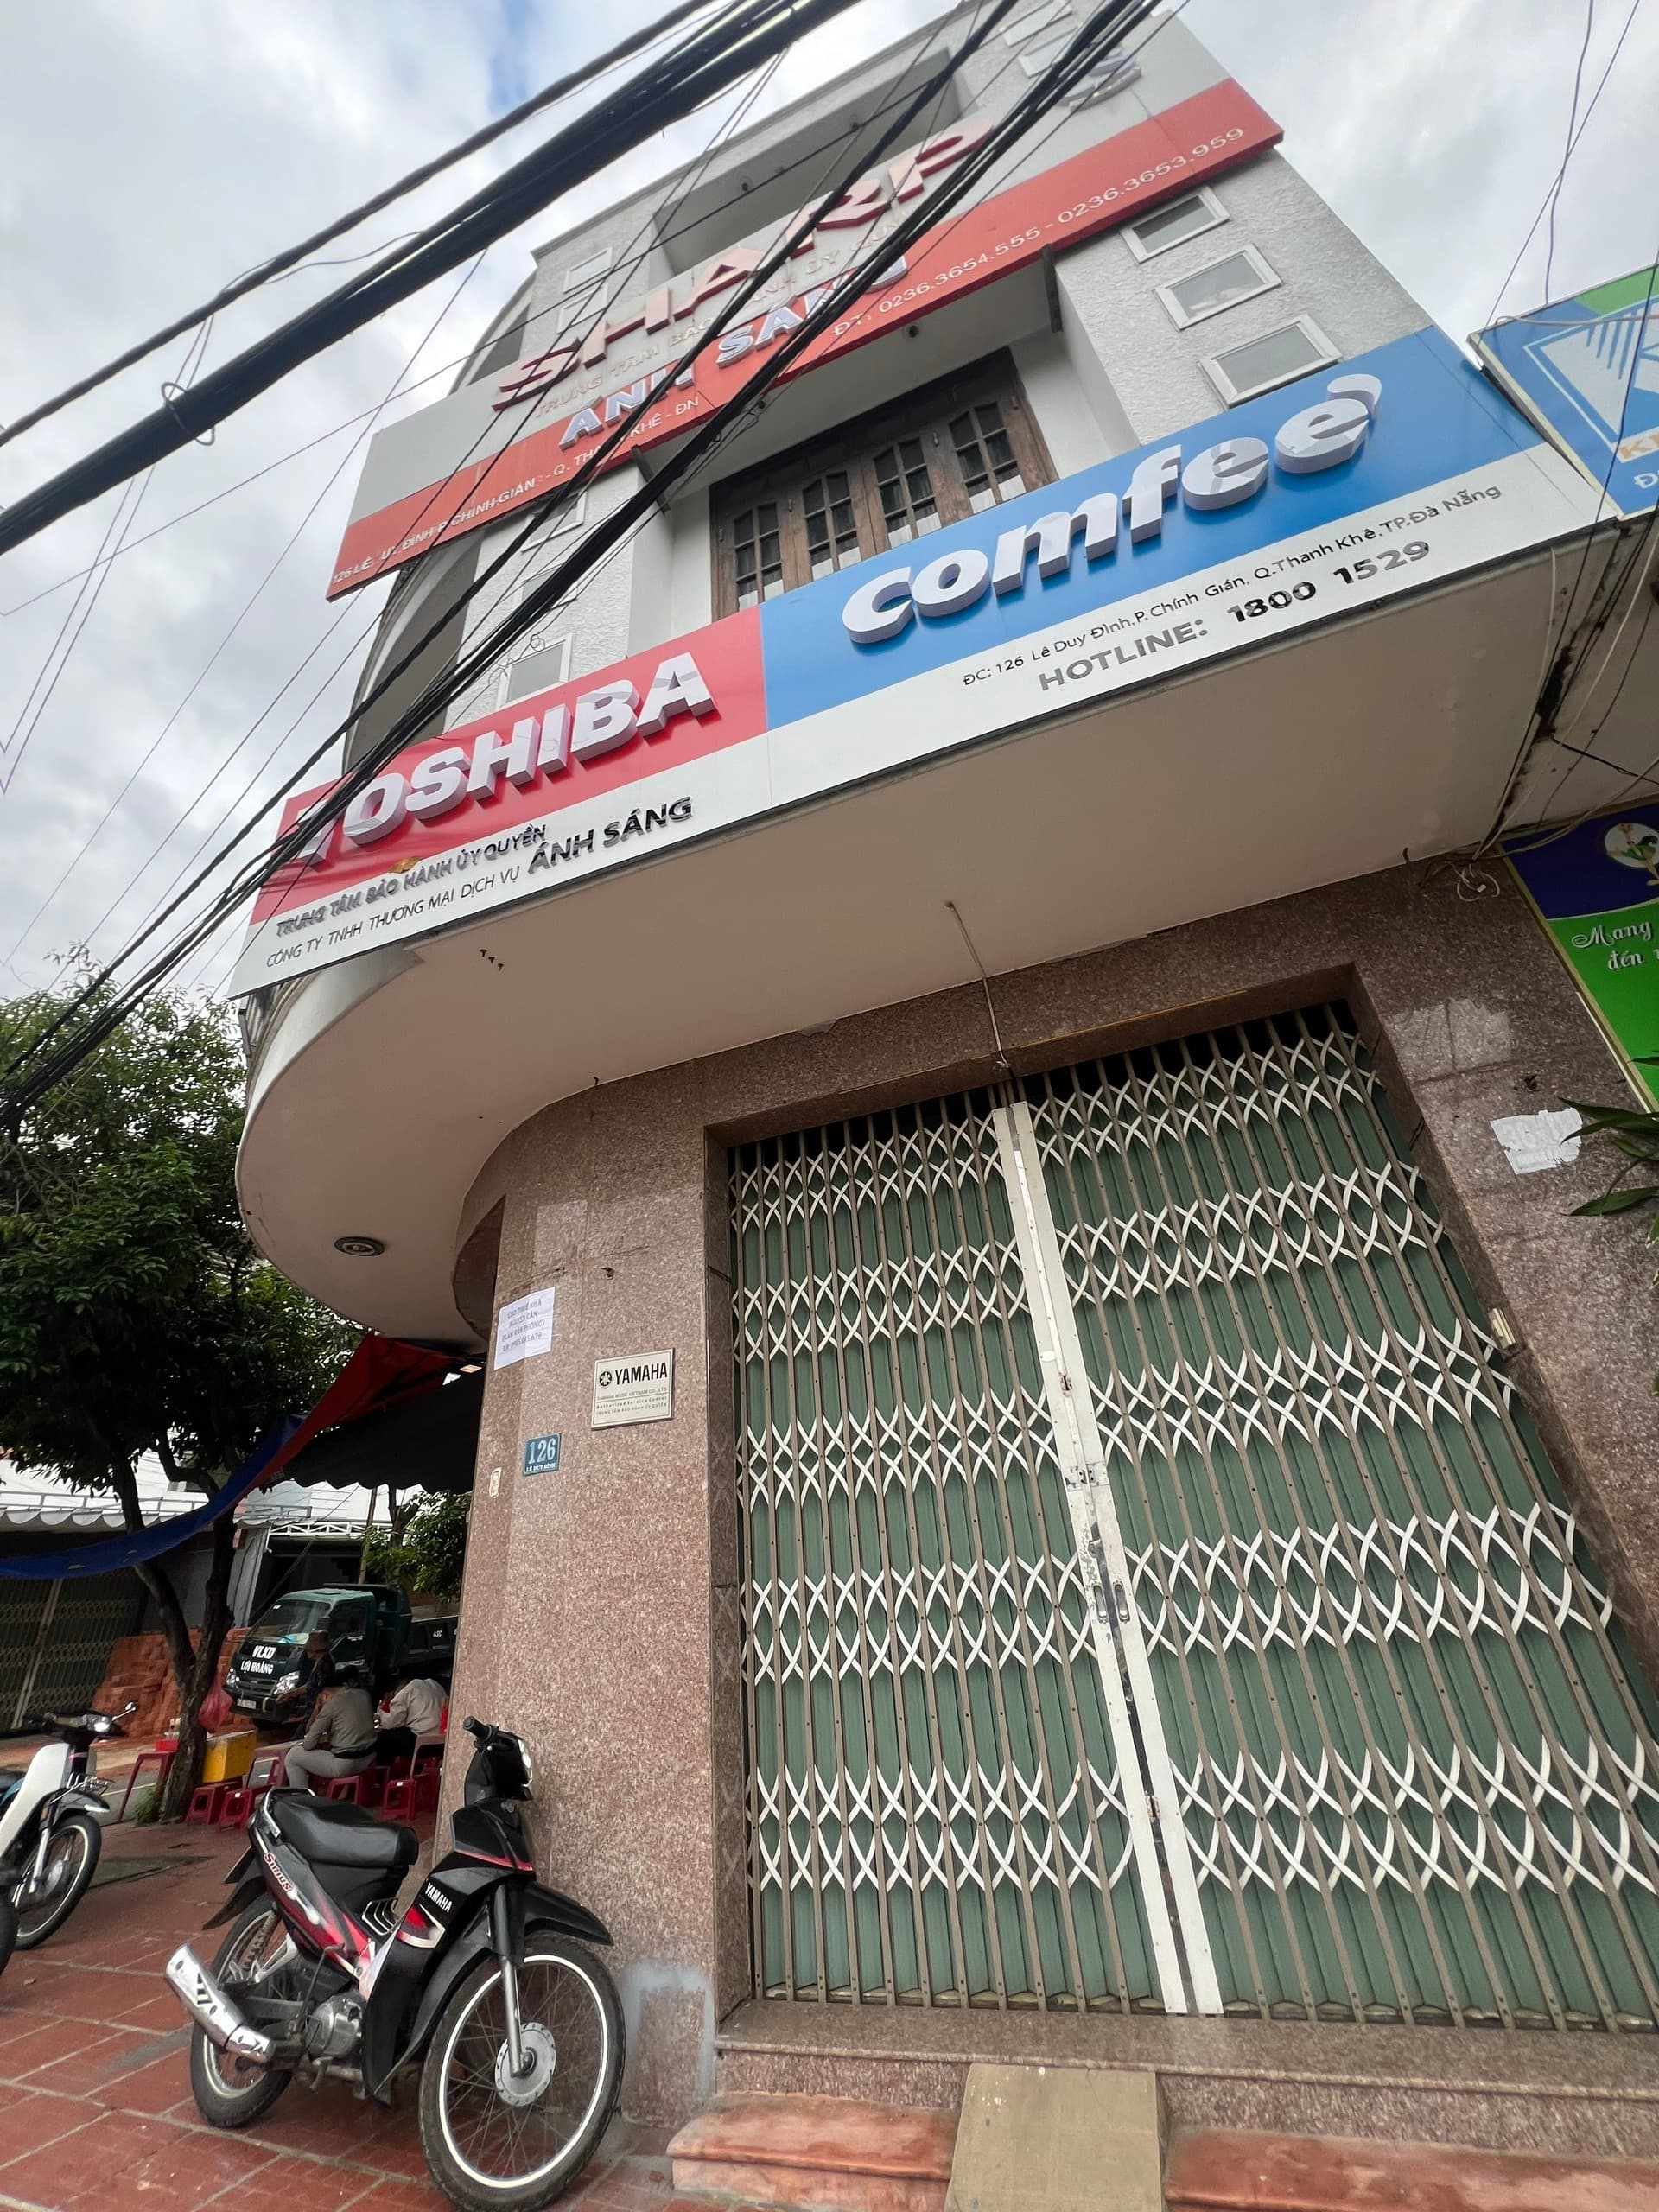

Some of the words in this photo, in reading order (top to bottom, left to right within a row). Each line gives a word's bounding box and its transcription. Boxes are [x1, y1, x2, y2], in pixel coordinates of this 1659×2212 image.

[492, 118, 996, 413] SHARP
[675, 396, 700, 416] ĐN
[878, 226, 1042, 314] 0236.3654.555
[1057, 127, 1244, 225] 0236.3653.959
[963, 666, 992, 686] ĐC:
[995, 655, 1025, 675] 126
[1031, 645, 1052, 662] Lê
[1053, 633, 1087, 653] Duy
[1150, 592, 1200, 619] Chính
[1444, 486, 1503, 512] Nẵng
[1038, 618, 1209, 692] HOTLINE:
[1227, 582, 1318, 623] 1800
[1332, 540, 1431, 585] 1529
[266, 943, 302, 968] CÔNG
[306, 935, 325, 953] TY
[328, 920, 364, 946] TNHH
[368, 899, 424, 931] THƯƠNG
[427, 887, 455, 912] MẠI
[460, 874, 496, 899] DỊCH
[499, 865, 521, 886] VỤ
[526, 829, 596, 875] ÁNH
[602, 796, 694, 849] SÁNG
[276, 904, 327, 938] TRUNG
[329, 890, 363, 918] TÂM
[365, 876, 399, 906] BẢO
[403, 857, 454, 892] HÀNH
[455, 848, 484, 872] ỦY
[483, 823, 547, 861] QUYỀN
[1571, 920, 1652, 949] Mang
[1608, 950, 1644, 971] đến
[615, 1362, 668, 1386] YAMAHA
[528, 1438, 556, 1465] 126
[251, 1644, 276, 1660] VLXD
[424, 1882, 453, 1913] YAMAHA
